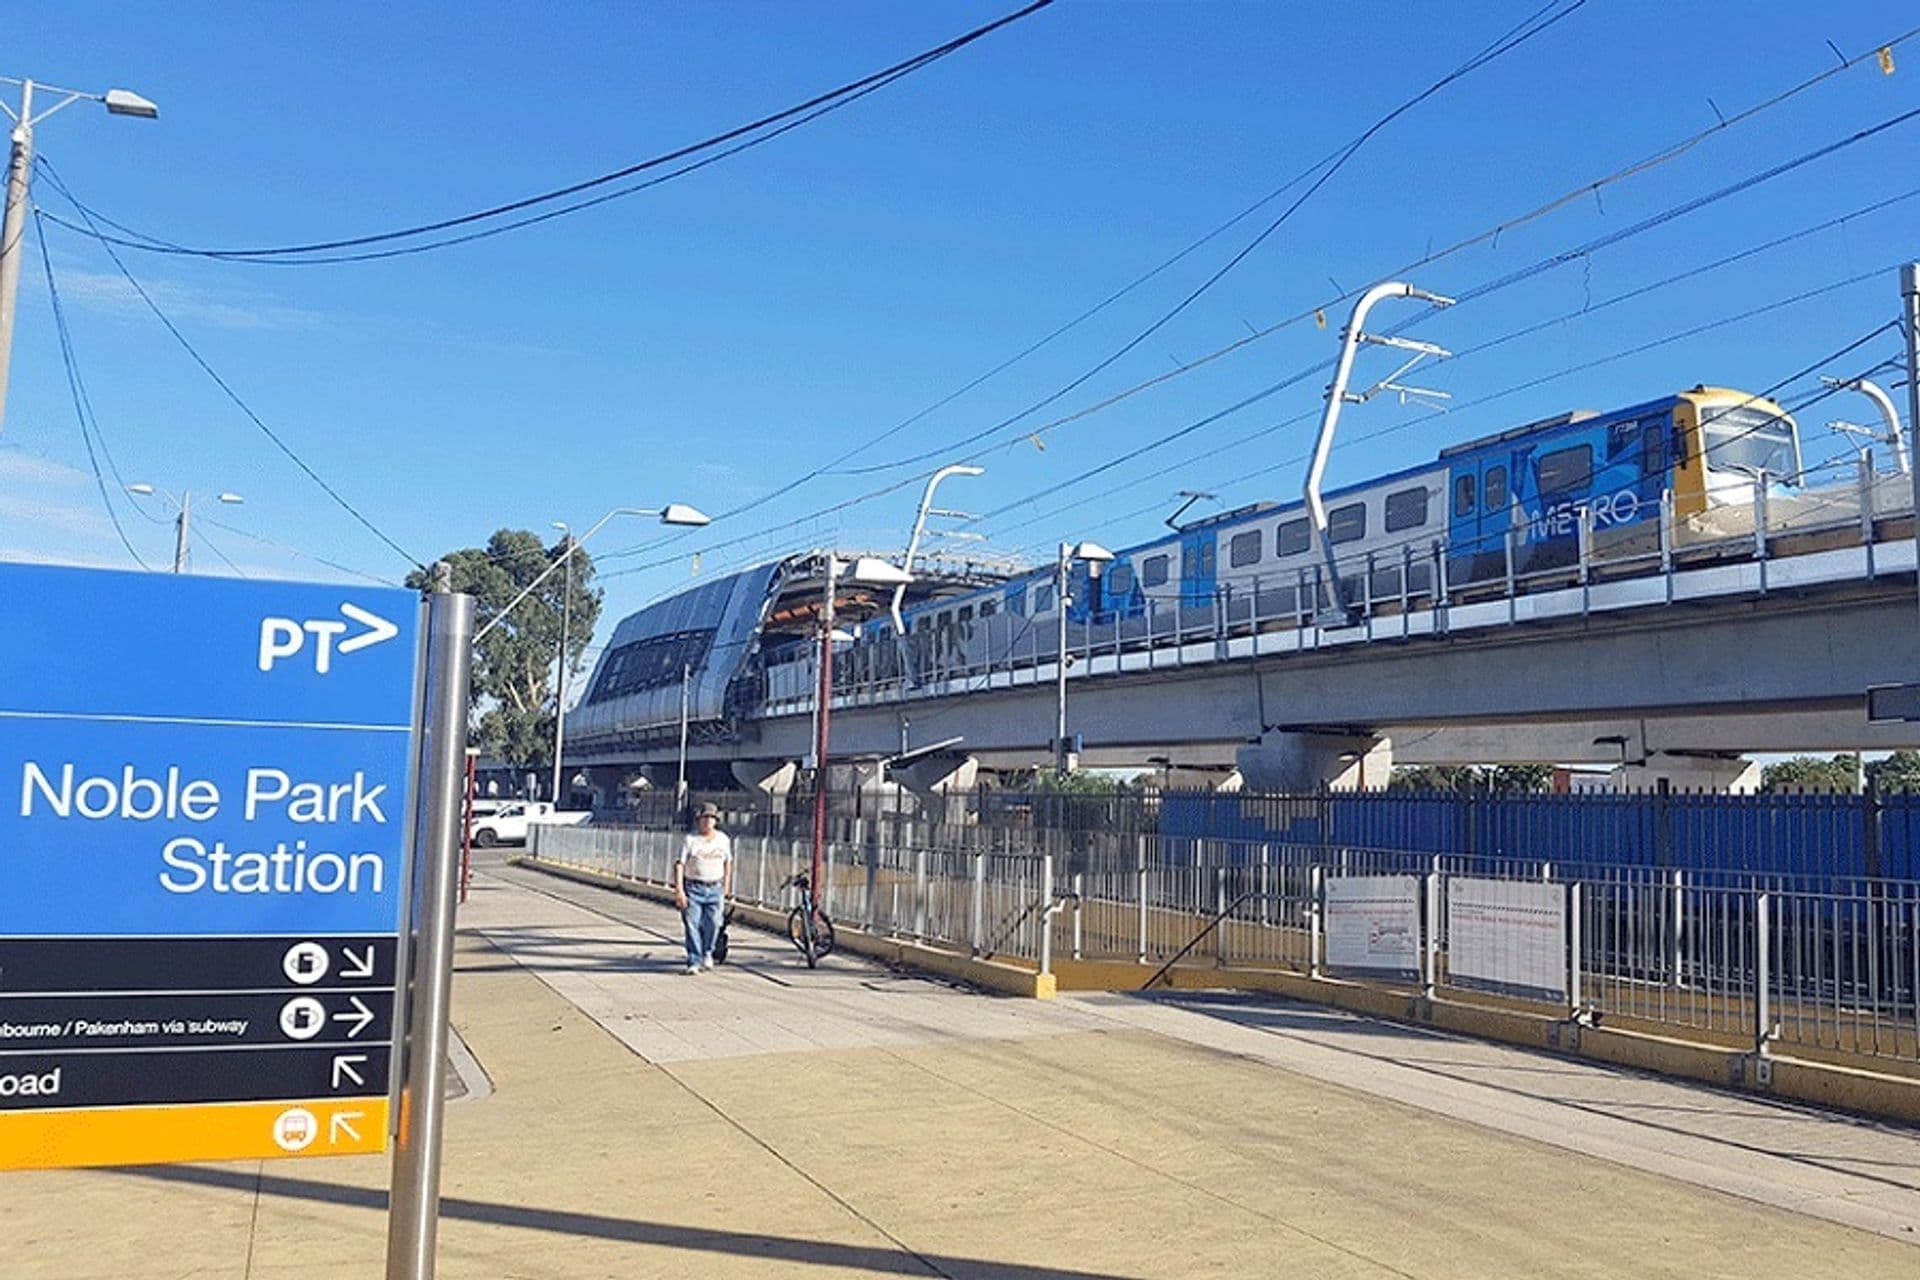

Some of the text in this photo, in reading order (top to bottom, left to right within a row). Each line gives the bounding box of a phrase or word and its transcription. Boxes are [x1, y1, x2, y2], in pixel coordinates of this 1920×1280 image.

[20, 761, 387, 824] Noble Park
[159, 837, 384, 894] Station
[0, 1021, 61, 1038] bourne
[74, 1019, 160, 1036] Pakenham
[162, 1018, 186, 1035] via
[187, 1018, 248, 1036] subway
